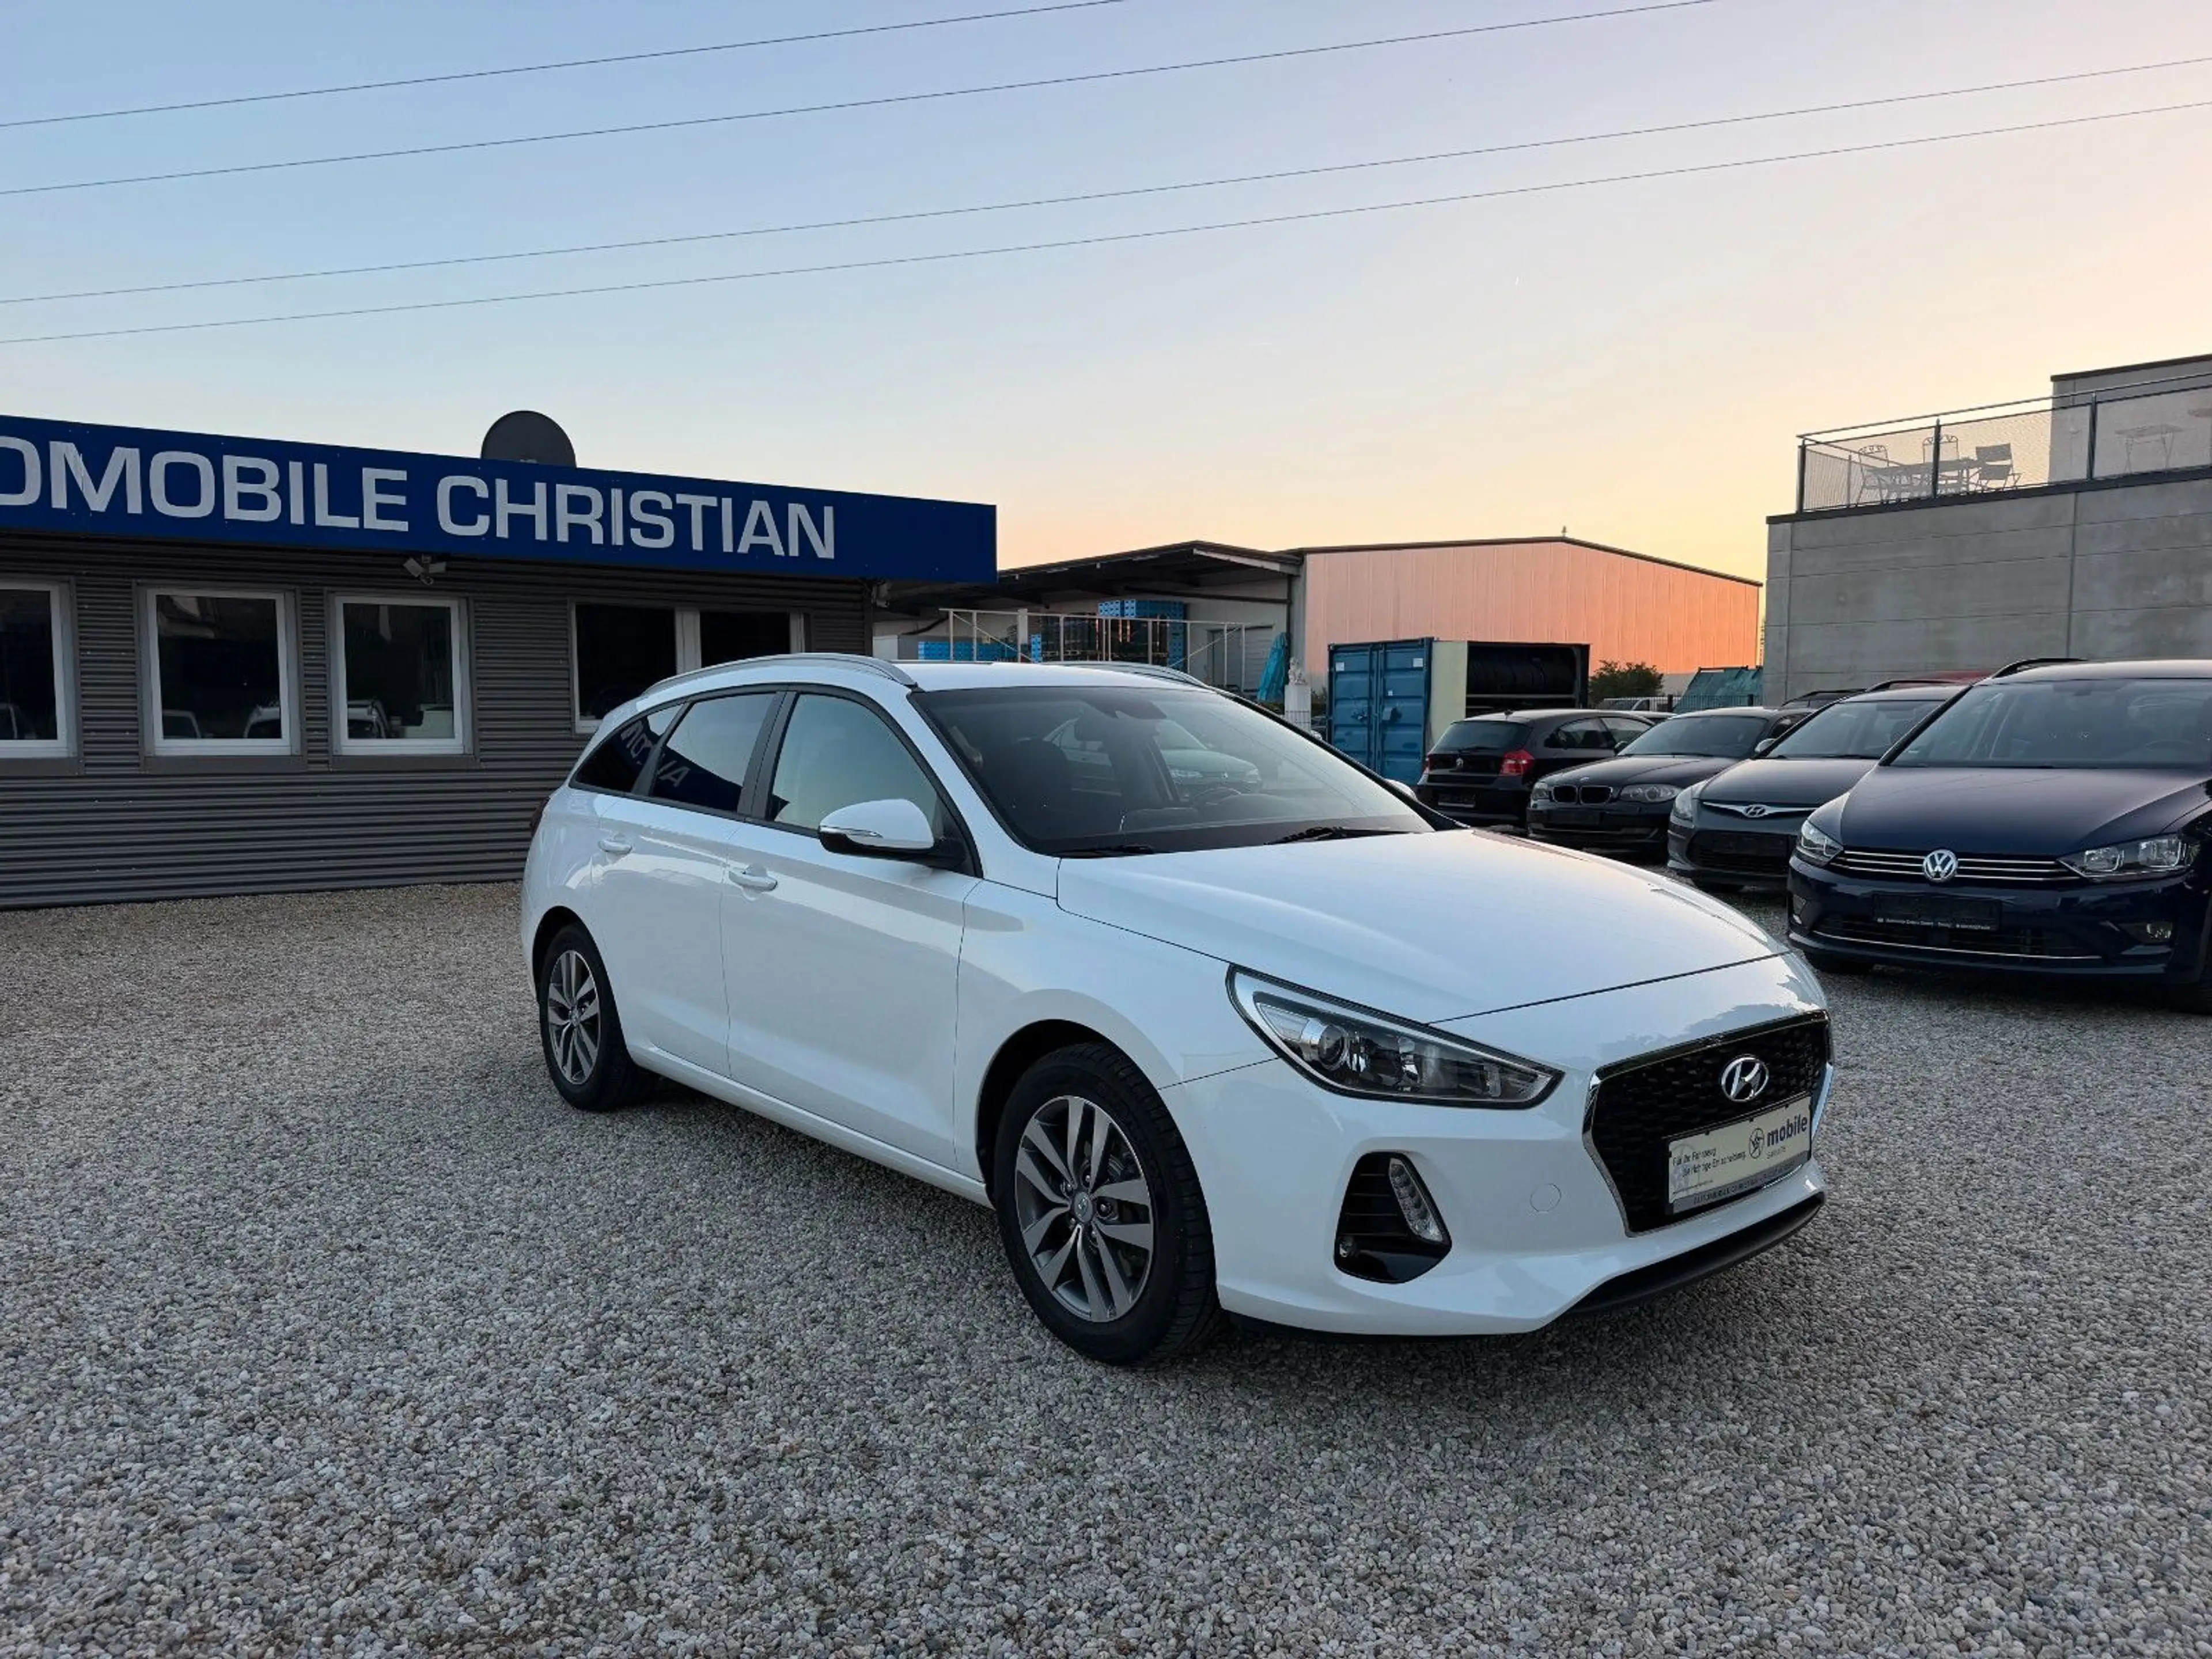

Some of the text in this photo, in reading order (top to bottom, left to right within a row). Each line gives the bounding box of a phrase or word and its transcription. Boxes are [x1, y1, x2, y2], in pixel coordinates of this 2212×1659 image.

[437, 476, 835, 559] CHRISTIAN
[1925, 850, 1956, 880] VW
[1767, 1113, 1808, 1147] mobile
